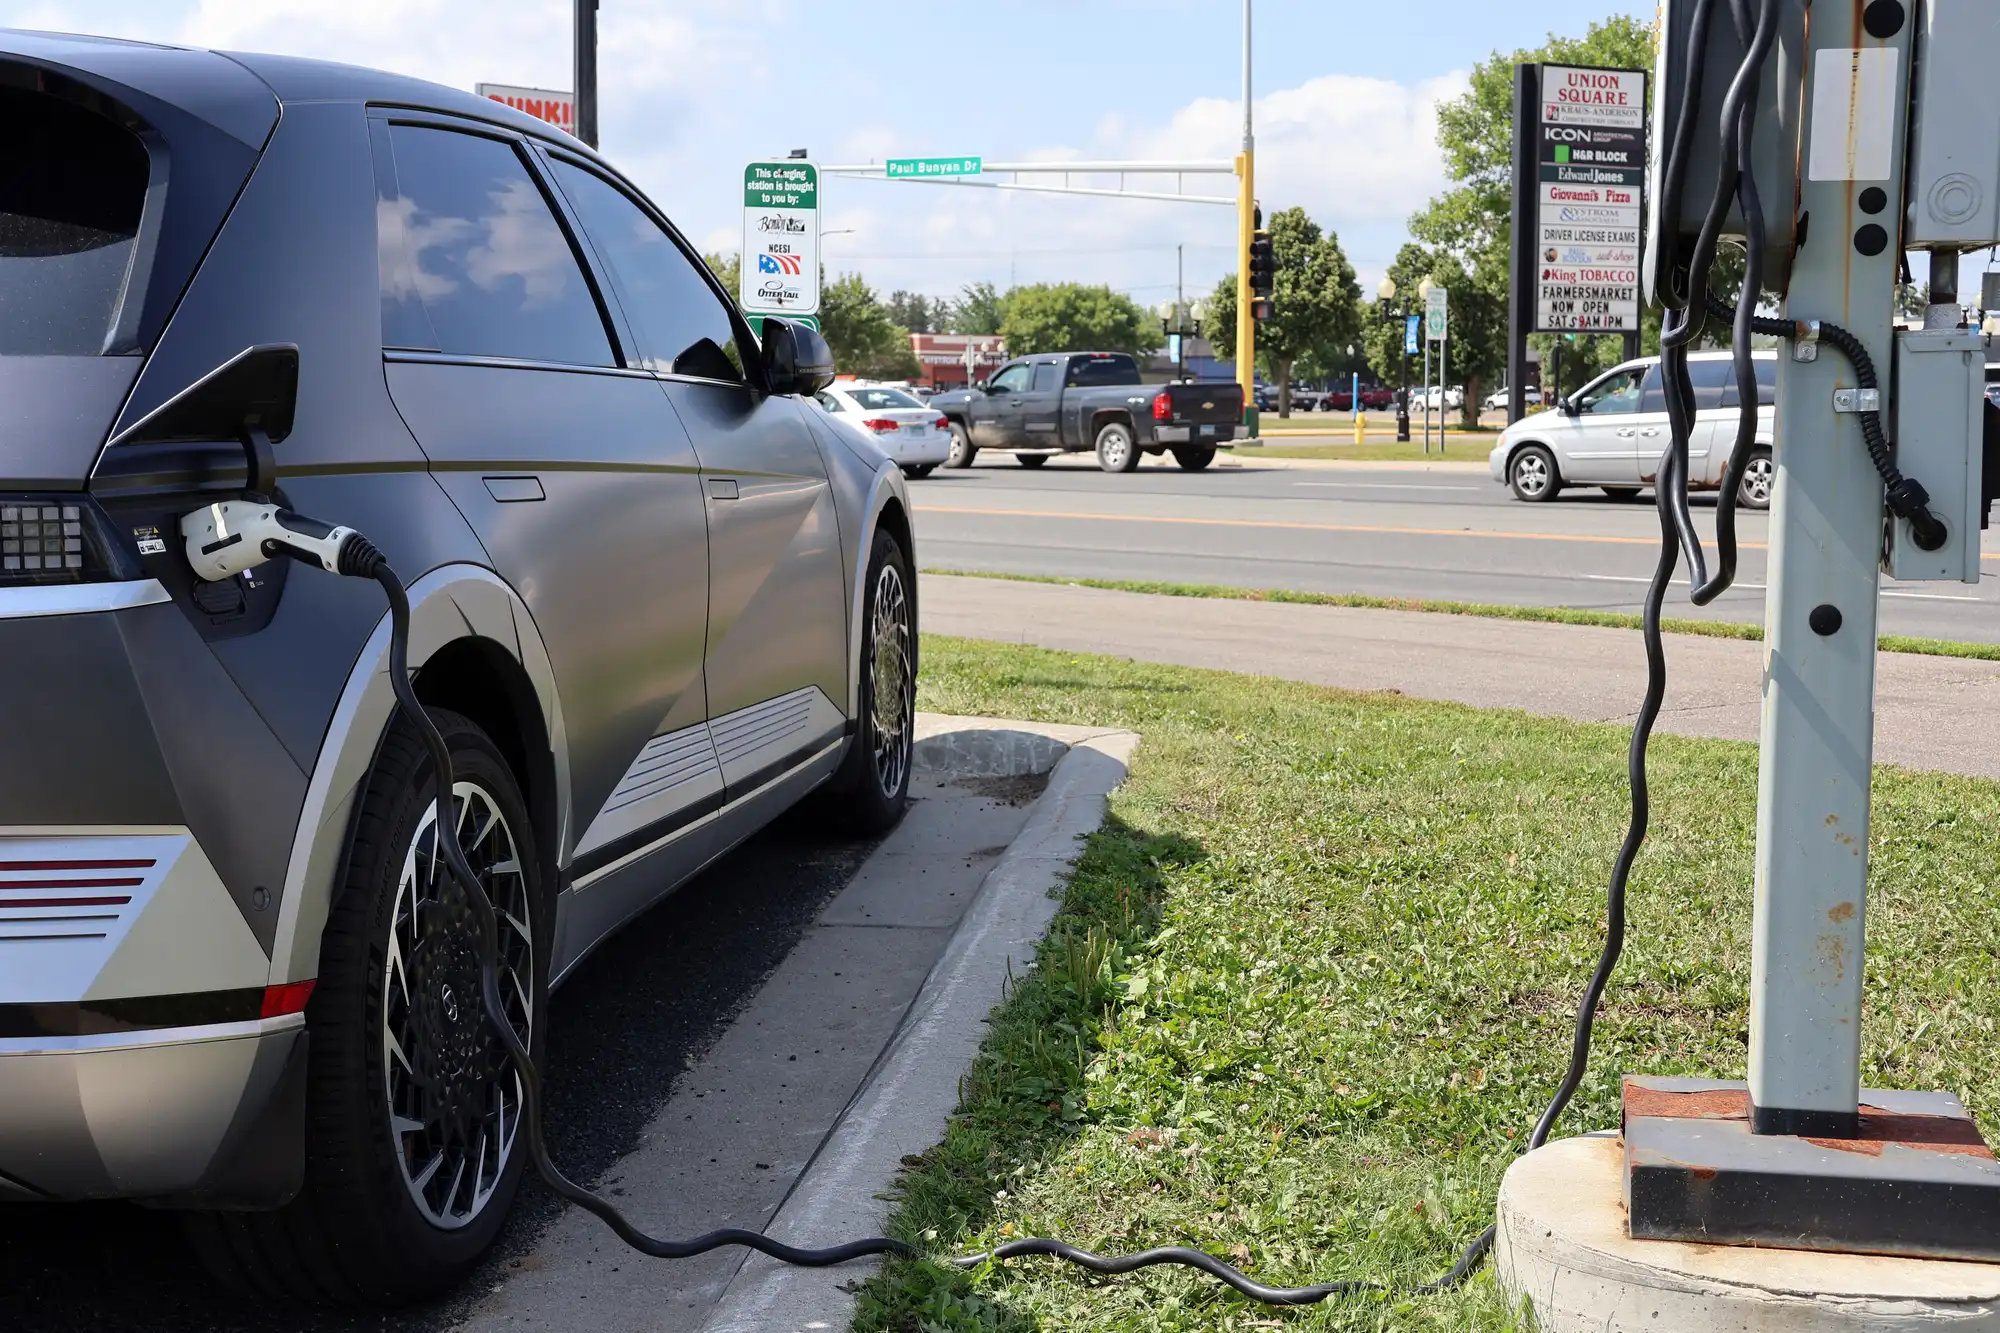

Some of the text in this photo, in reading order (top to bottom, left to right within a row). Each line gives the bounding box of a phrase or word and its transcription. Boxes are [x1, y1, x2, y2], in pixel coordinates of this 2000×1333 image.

[1568, 72, 1620, 89] UNION
[1558, 88, 1628, 105] SQUARE
[1545, 127, 1591, 142] ICON
[1573, 149, 1628, 162] H&R BLOCK
[755, 168, 771, 178] This
[889, 160, 978, 175] Paul Bunyan Dr
[747, 181, 814, 194] station is brought
[761, 193, 799, 205] to you by:
[1550, 187, 1631, 203] Giovanni's Pizza
[1544, 229, 1636, 243] DRIVER LICENSE EXAMS
[768, 244, 791, 254] NCESI
[1551, 268, 1635, 284] King TOBACCO
[1552, 301, 1609, 313] NOW OPEN
